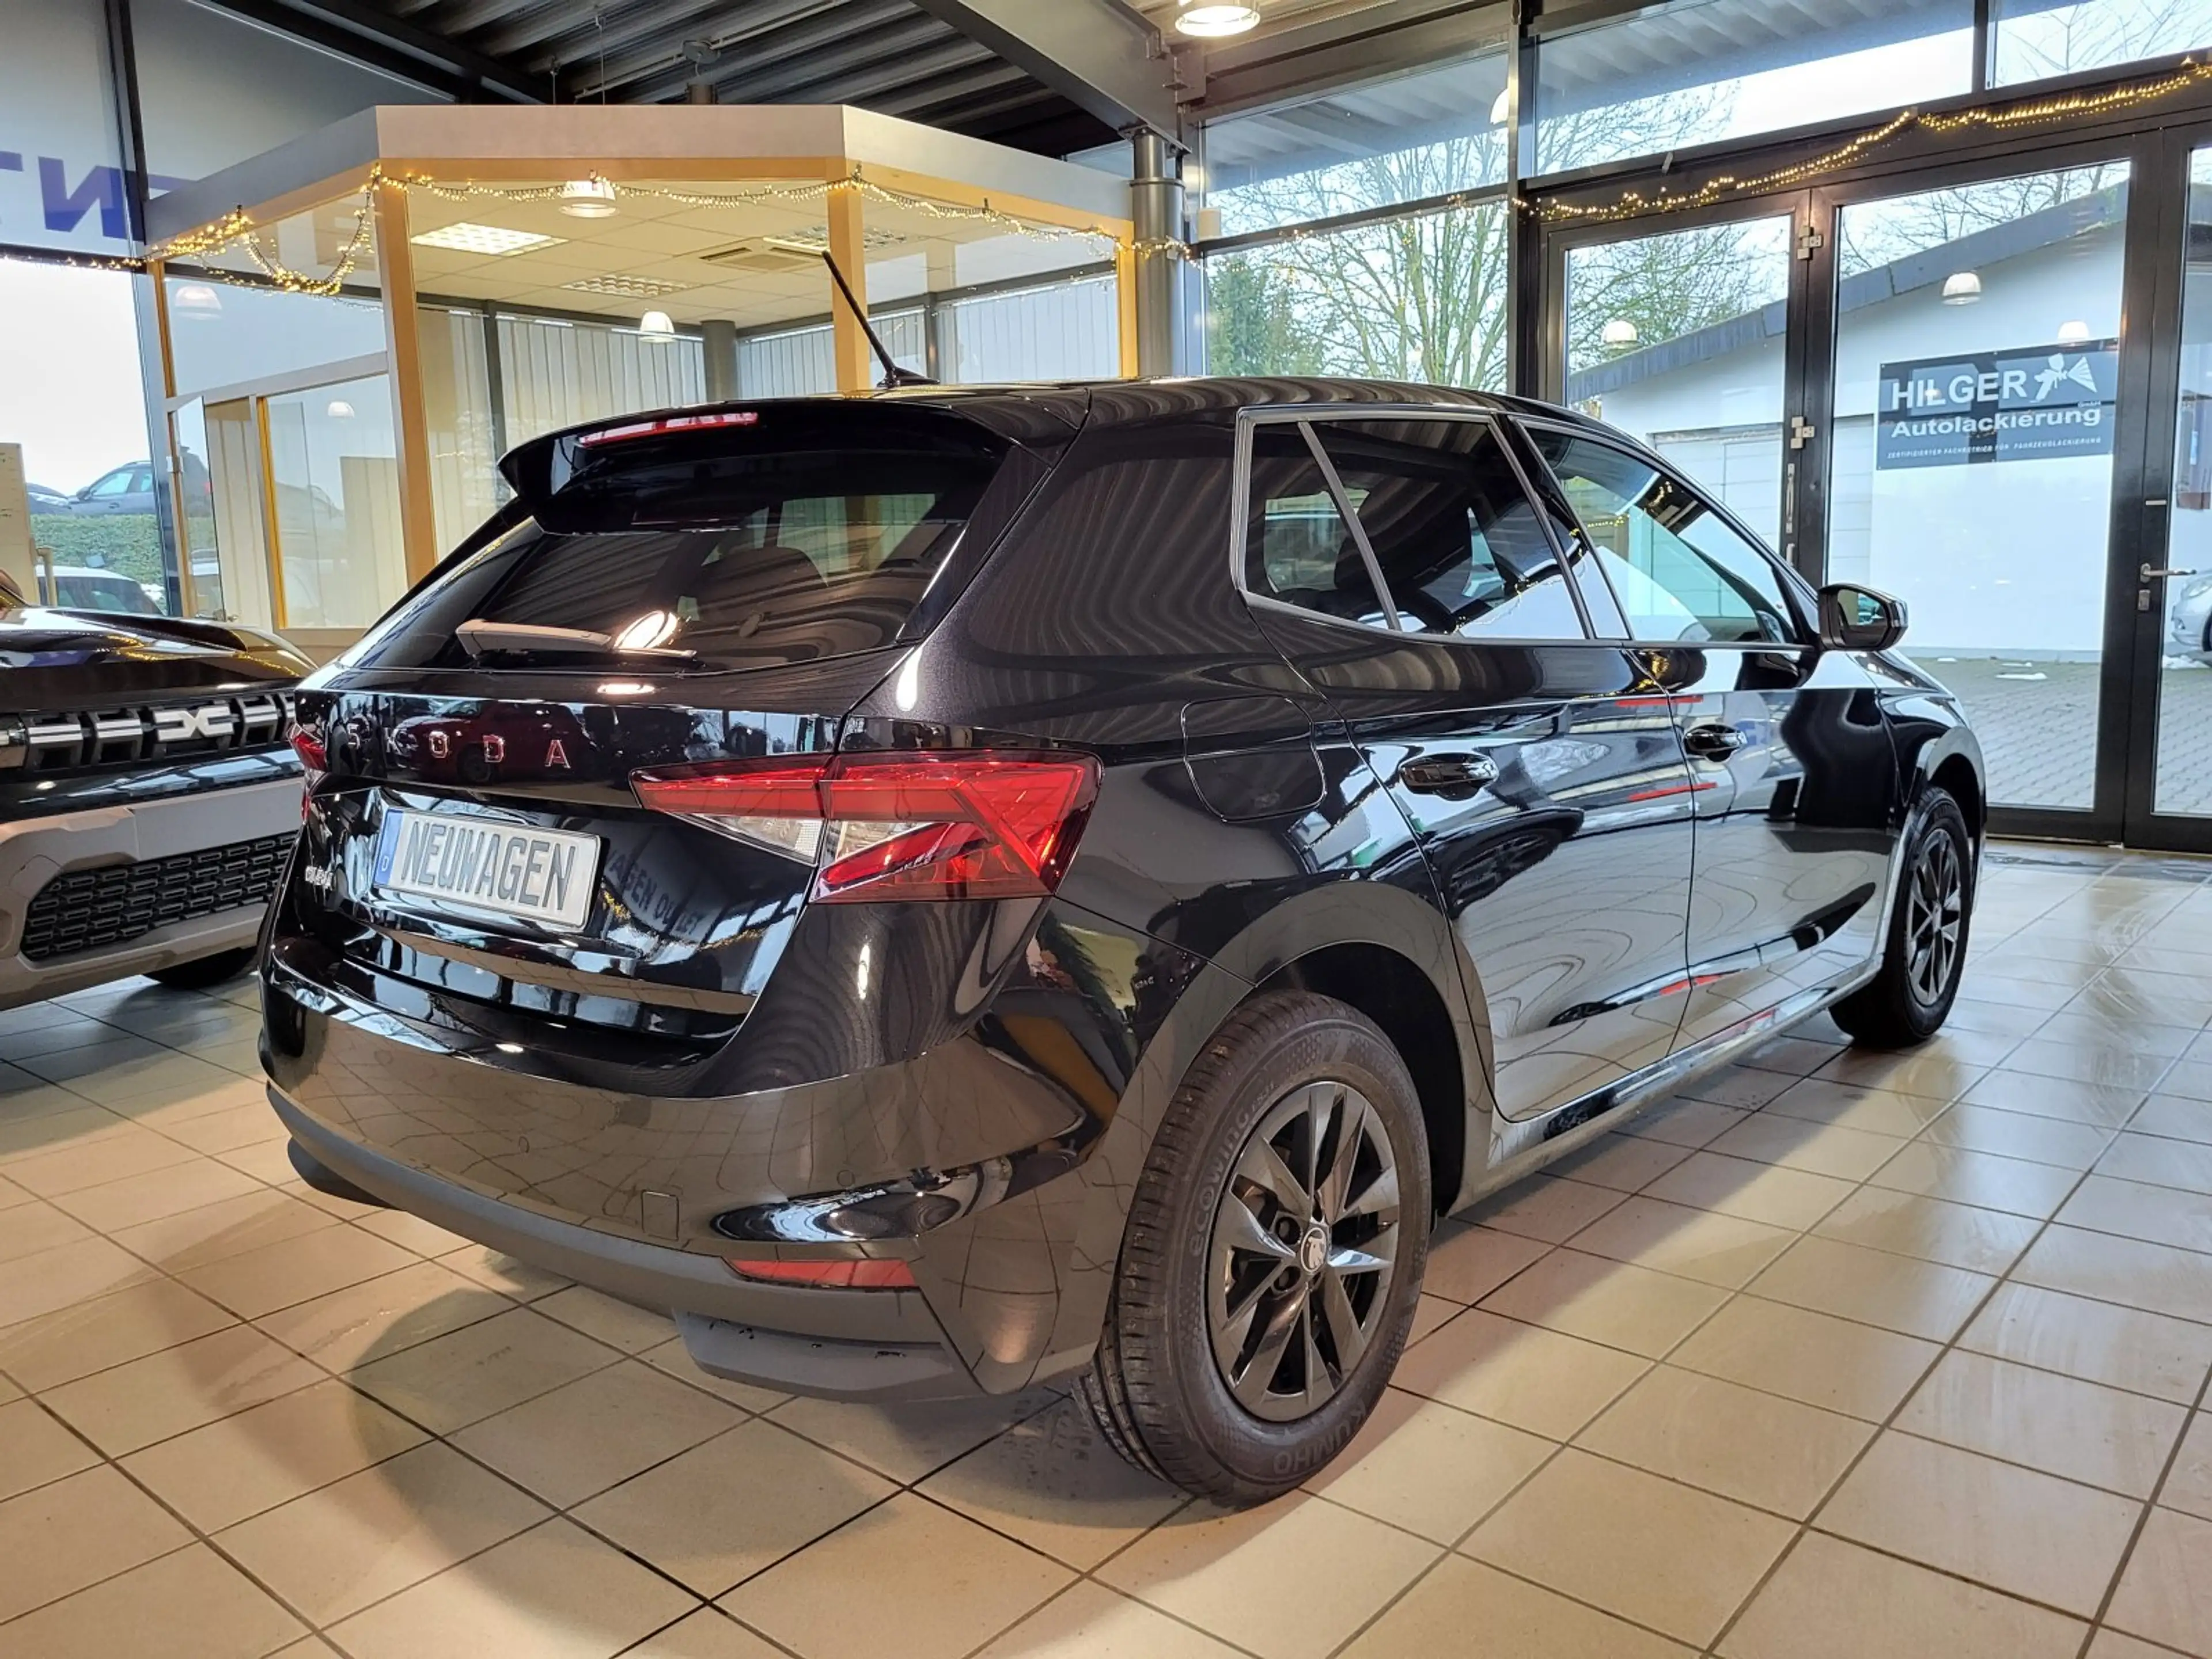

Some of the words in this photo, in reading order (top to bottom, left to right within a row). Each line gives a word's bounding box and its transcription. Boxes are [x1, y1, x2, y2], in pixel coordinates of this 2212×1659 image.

[1891, 369, 2027, 408] HILGER
[1891, 408, 2101, 438] Autolackierung
[381, 855, 389, 872] D
[401, 820, 575, 911] NEUWAGEN
